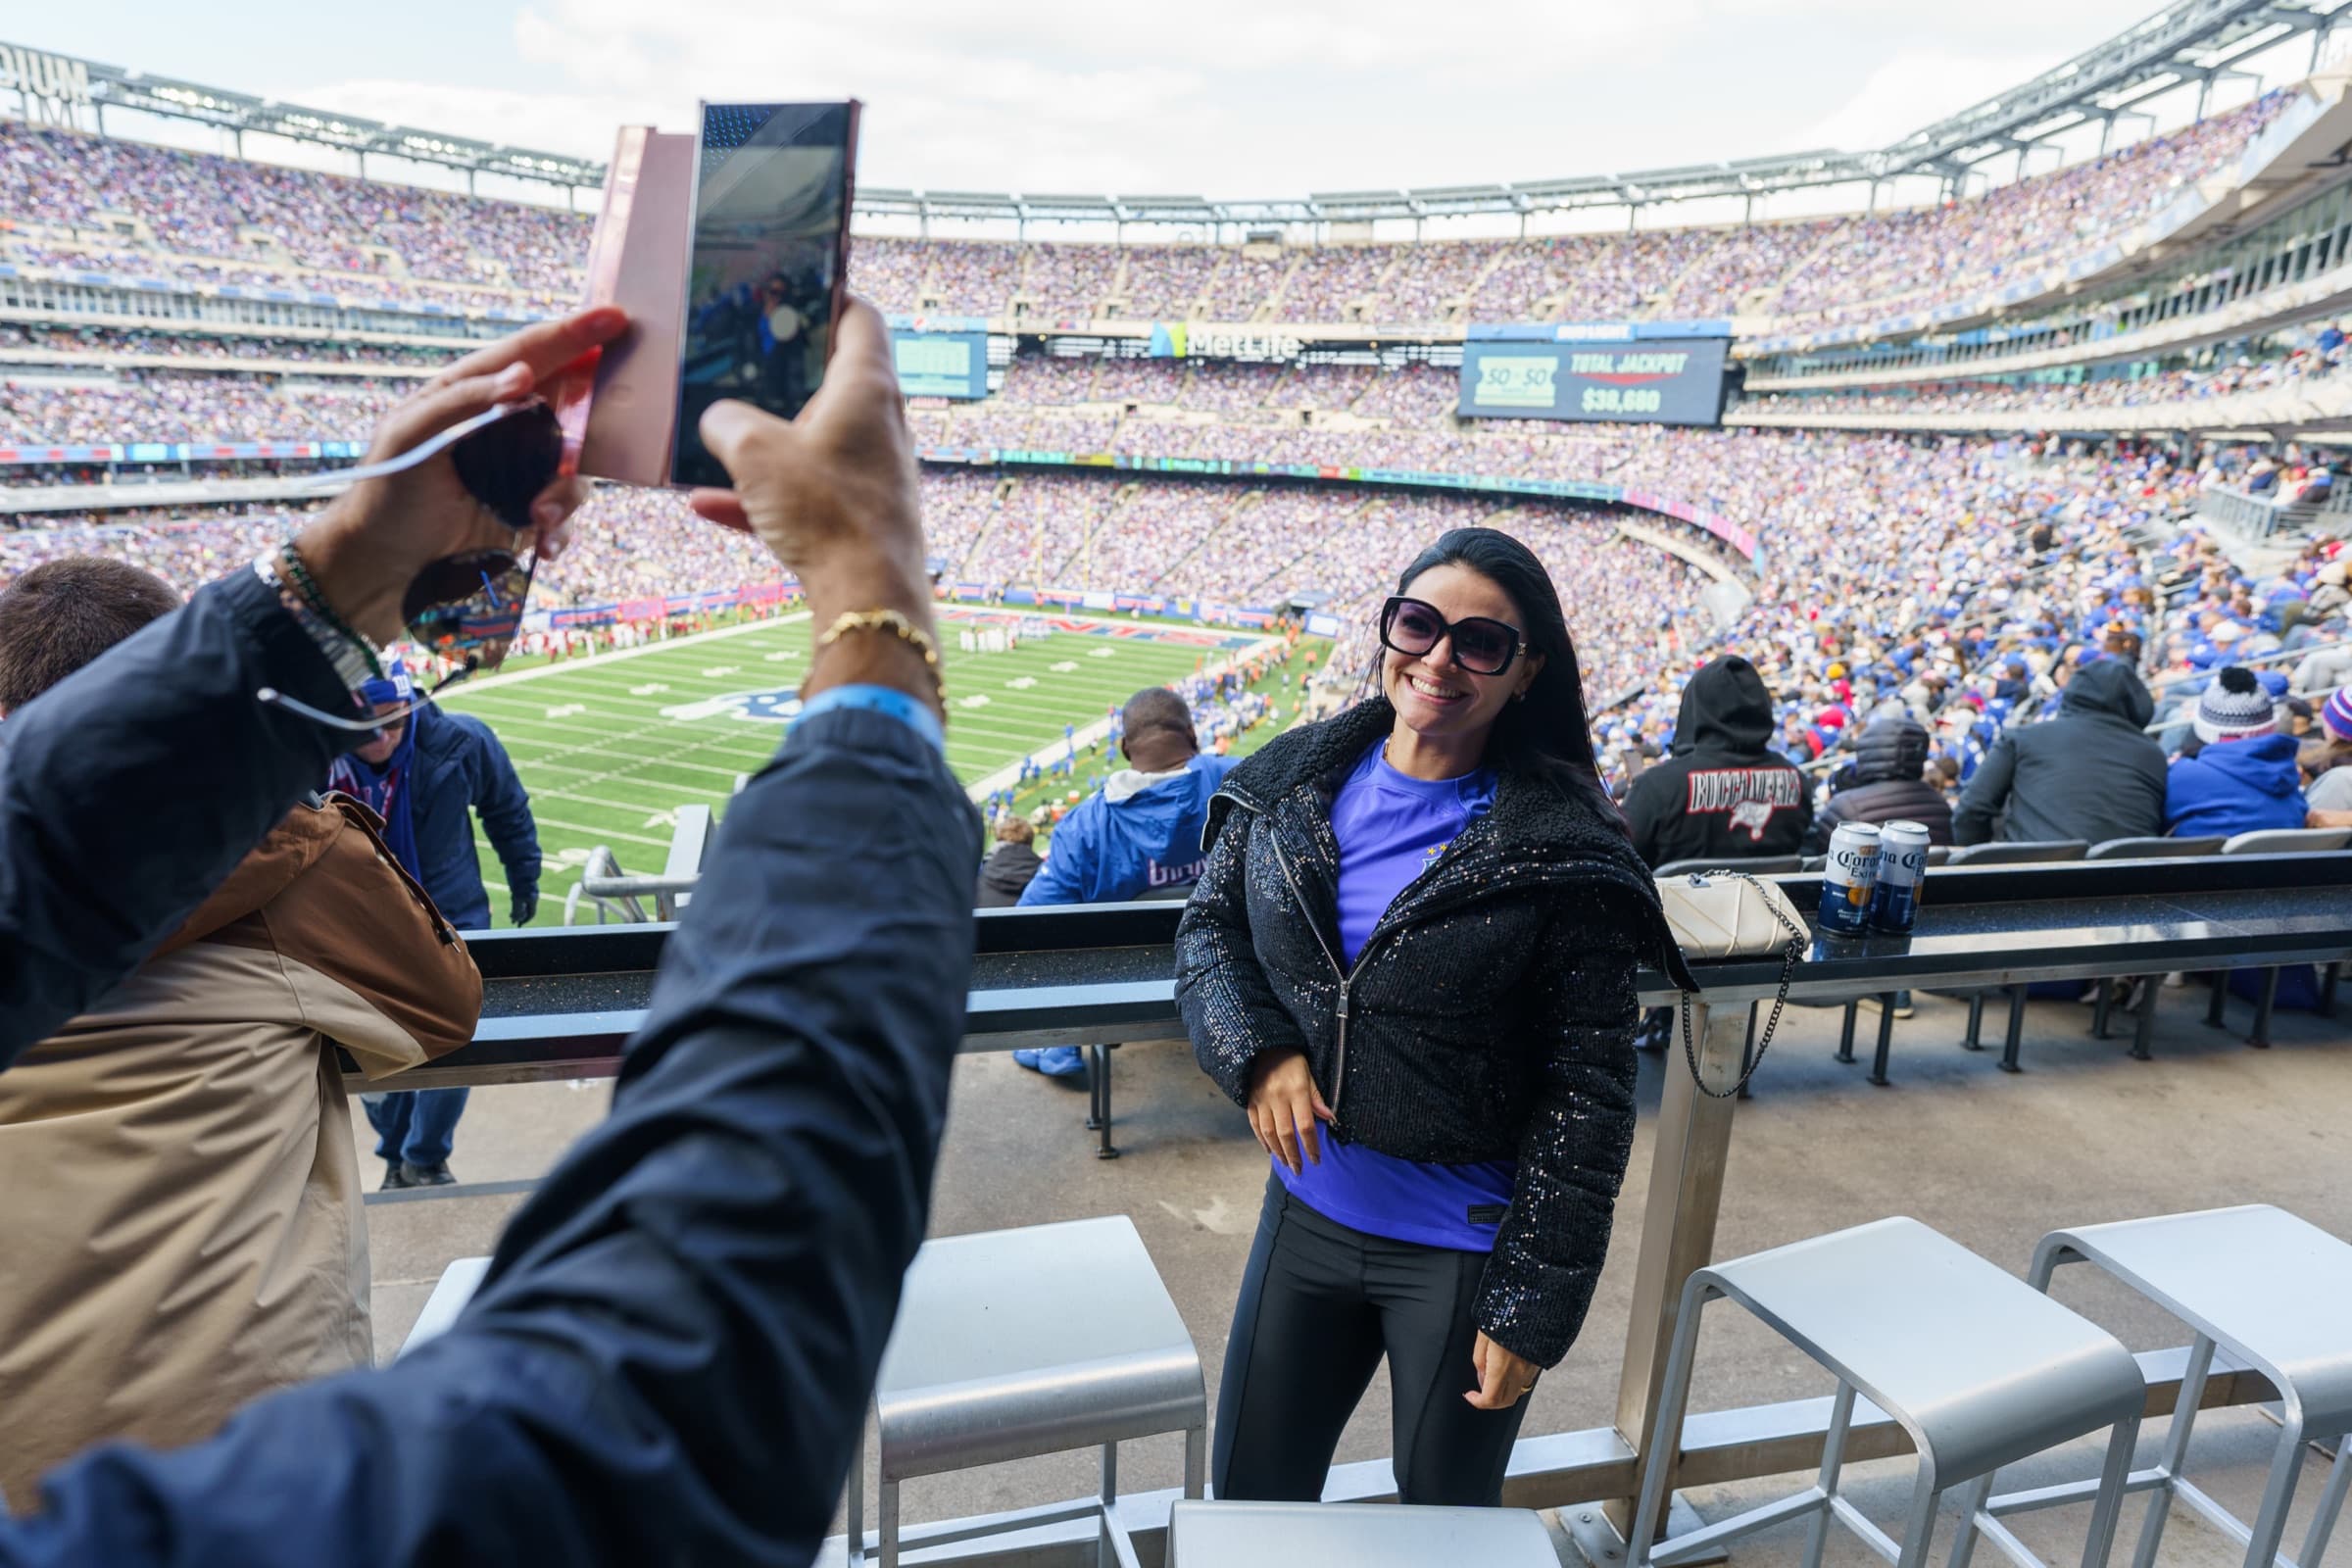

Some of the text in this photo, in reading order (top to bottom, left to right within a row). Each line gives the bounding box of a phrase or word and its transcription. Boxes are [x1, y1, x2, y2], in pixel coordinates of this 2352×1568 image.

[1187, 329, 1298, 357] MetLife
[1571, 353, 1689, 373] TOTAL JACKPOT
